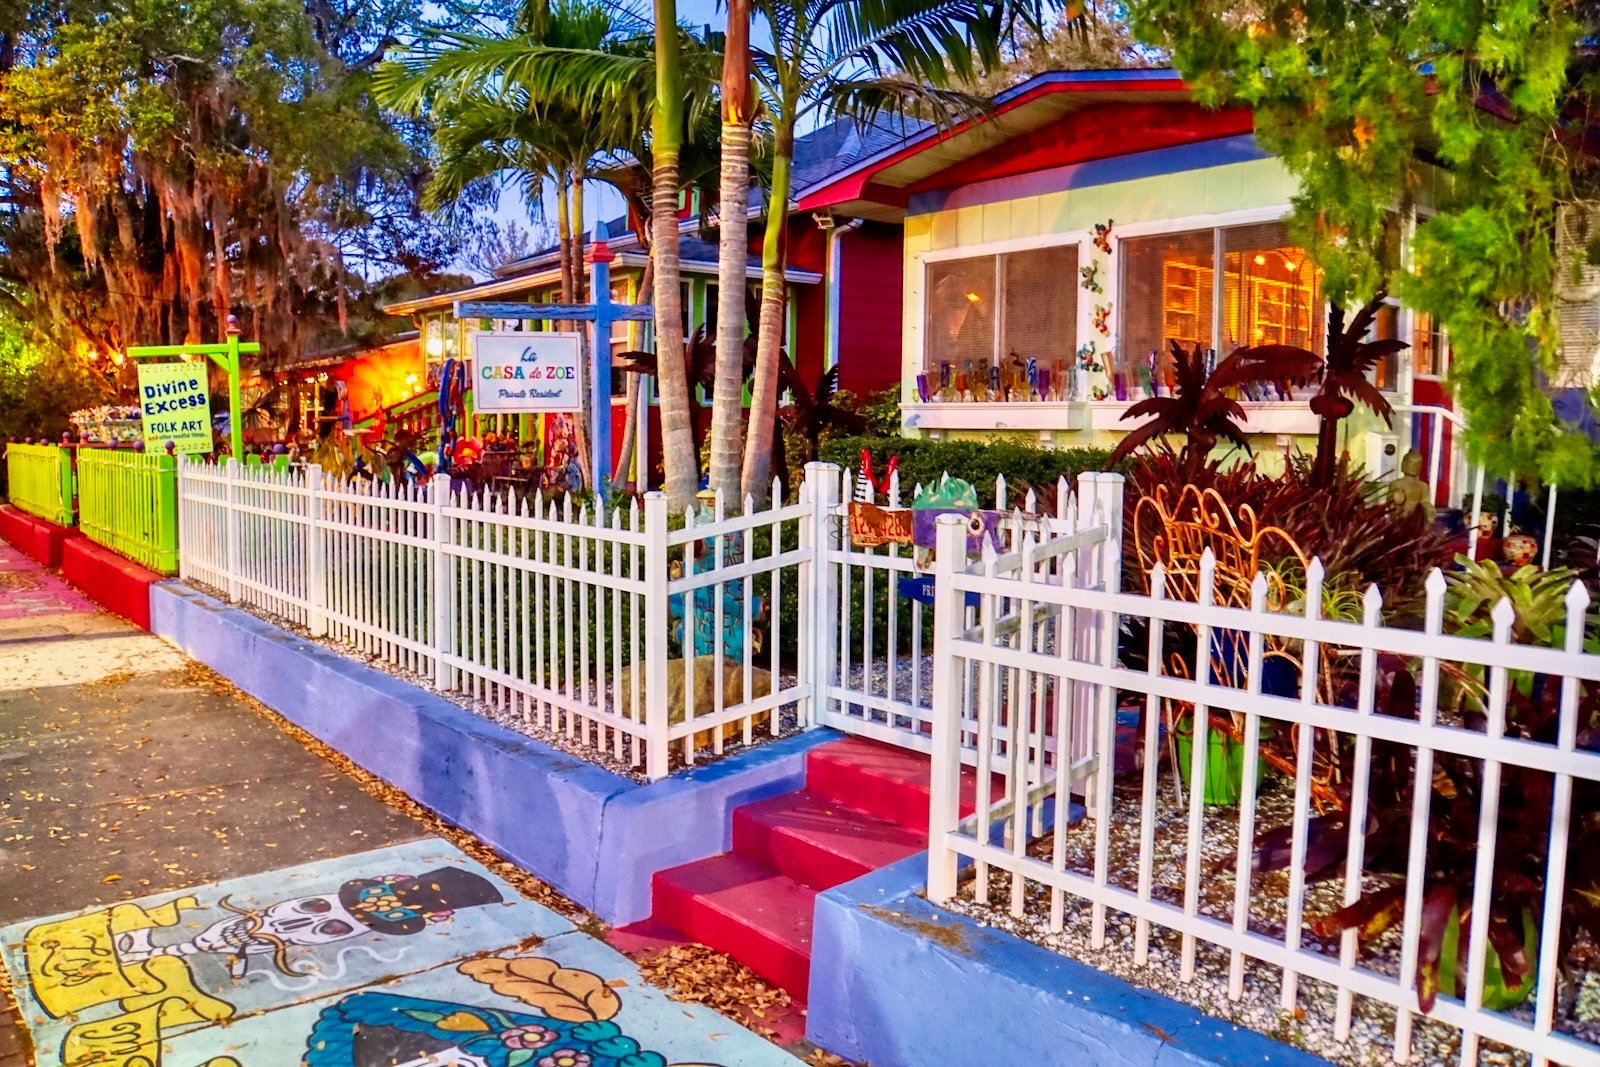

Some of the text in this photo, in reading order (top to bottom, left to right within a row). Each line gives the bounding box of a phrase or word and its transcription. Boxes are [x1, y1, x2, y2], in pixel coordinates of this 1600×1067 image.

[520, 346, 538, 363] La
[481, 366, 575, 379] CASA de ZOE
[144, 379, 198, 399] Divine
[498, 389, 563, 399] Private Resident
[144, 393, 206, 415] Excess
[150, 420, 203, 433] FOLK ART
